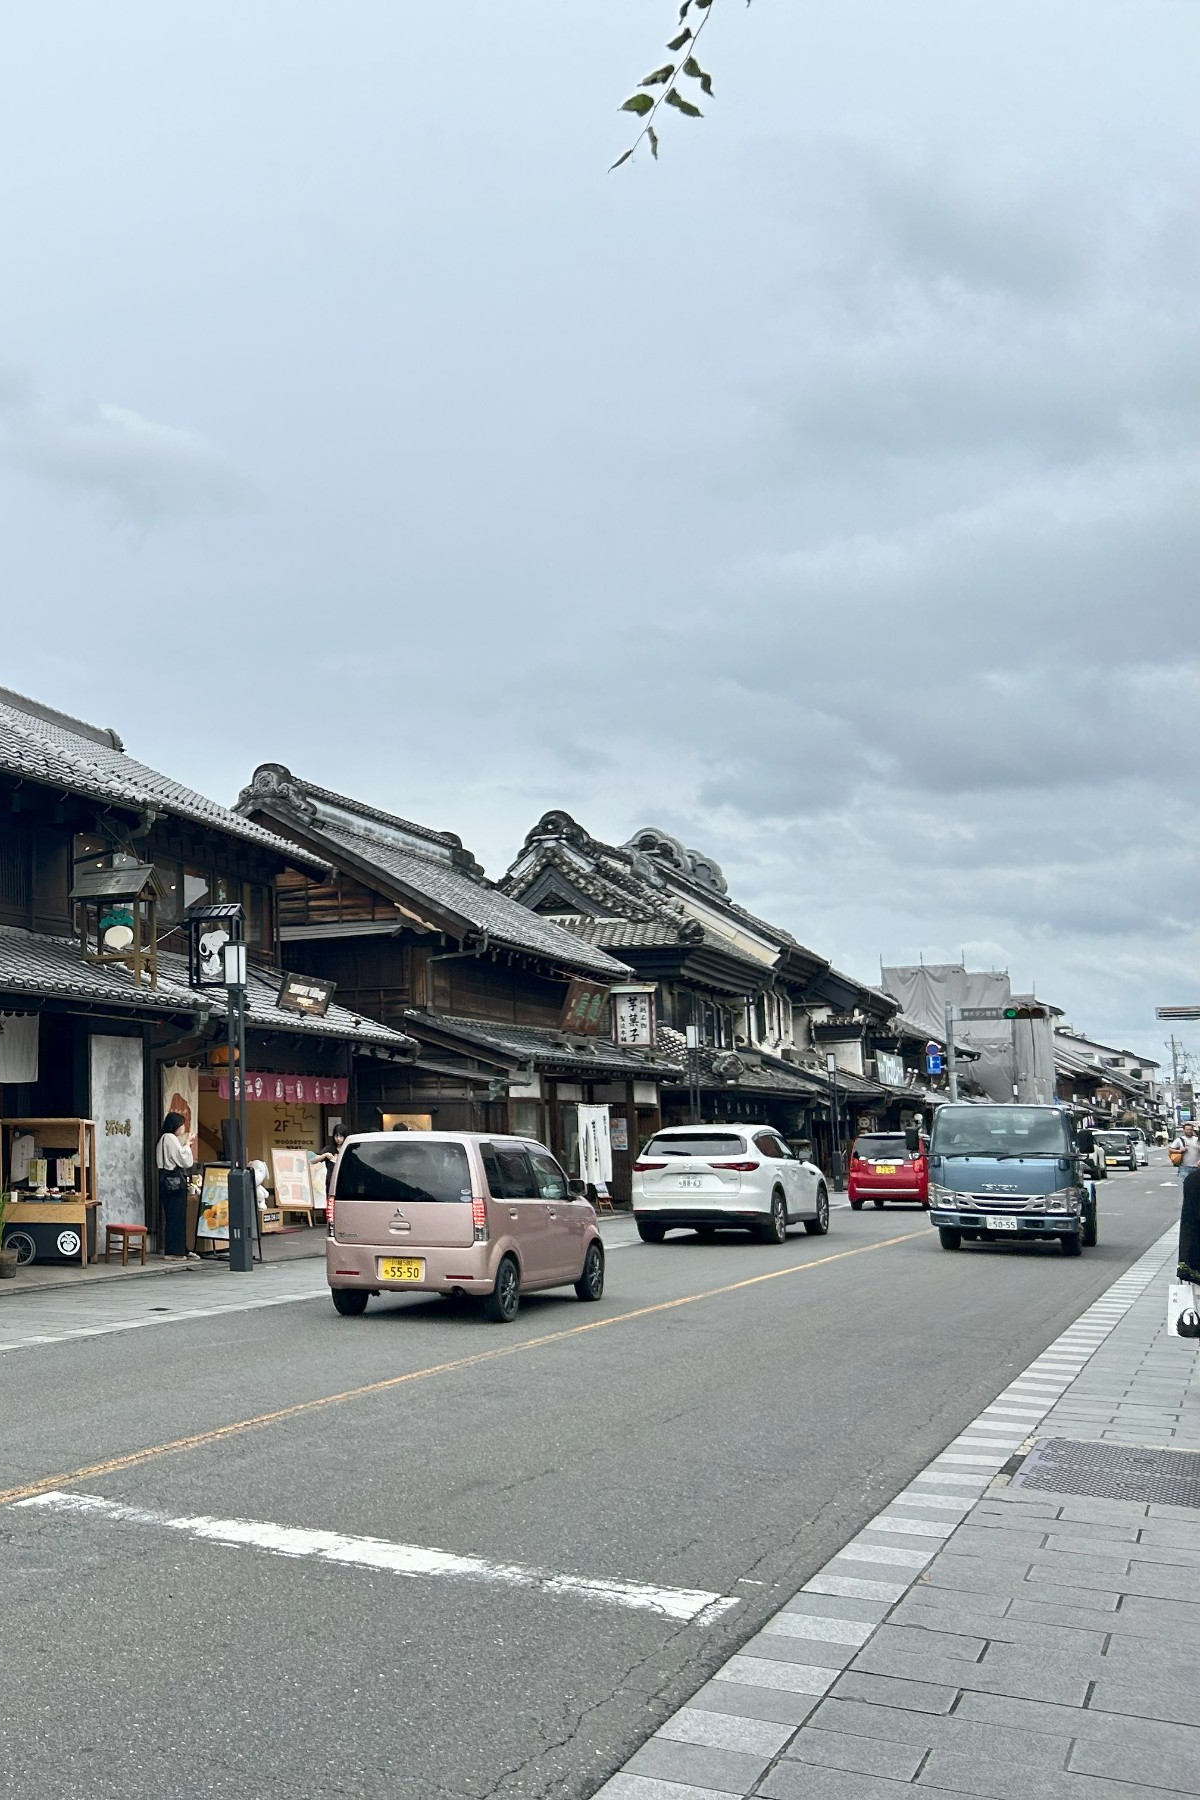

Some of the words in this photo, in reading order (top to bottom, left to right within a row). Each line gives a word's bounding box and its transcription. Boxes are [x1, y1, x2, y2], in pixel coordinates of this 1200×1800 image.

[627, 996, 639, 1042] 芋菓子
[274, 1120, 290, 1132] 2F
[390, 1266, 419, 1278] 55-50
